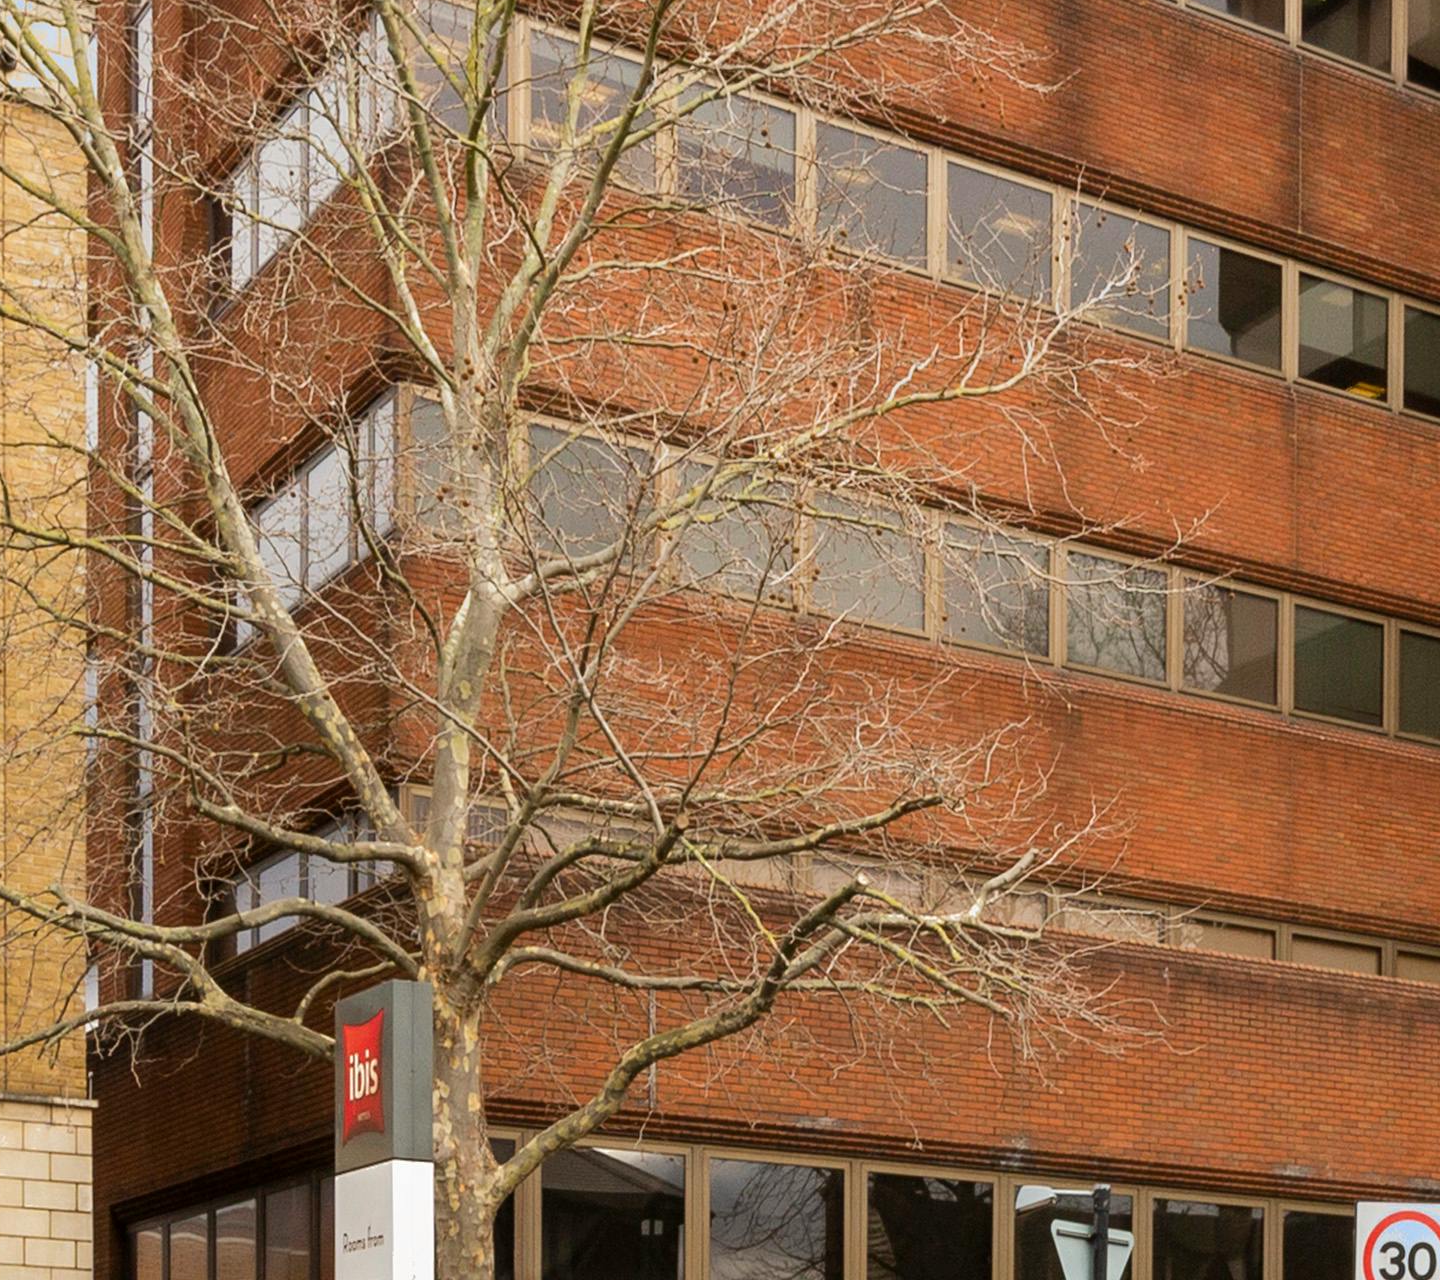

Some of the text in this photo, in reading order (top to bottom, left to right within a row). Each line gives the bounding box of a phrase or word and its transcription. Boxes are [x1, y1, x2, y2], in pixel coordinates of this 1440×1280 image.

[349, 1048, 379, 1101] ibis
[342, 1224, 384, 1254] Rooms from
